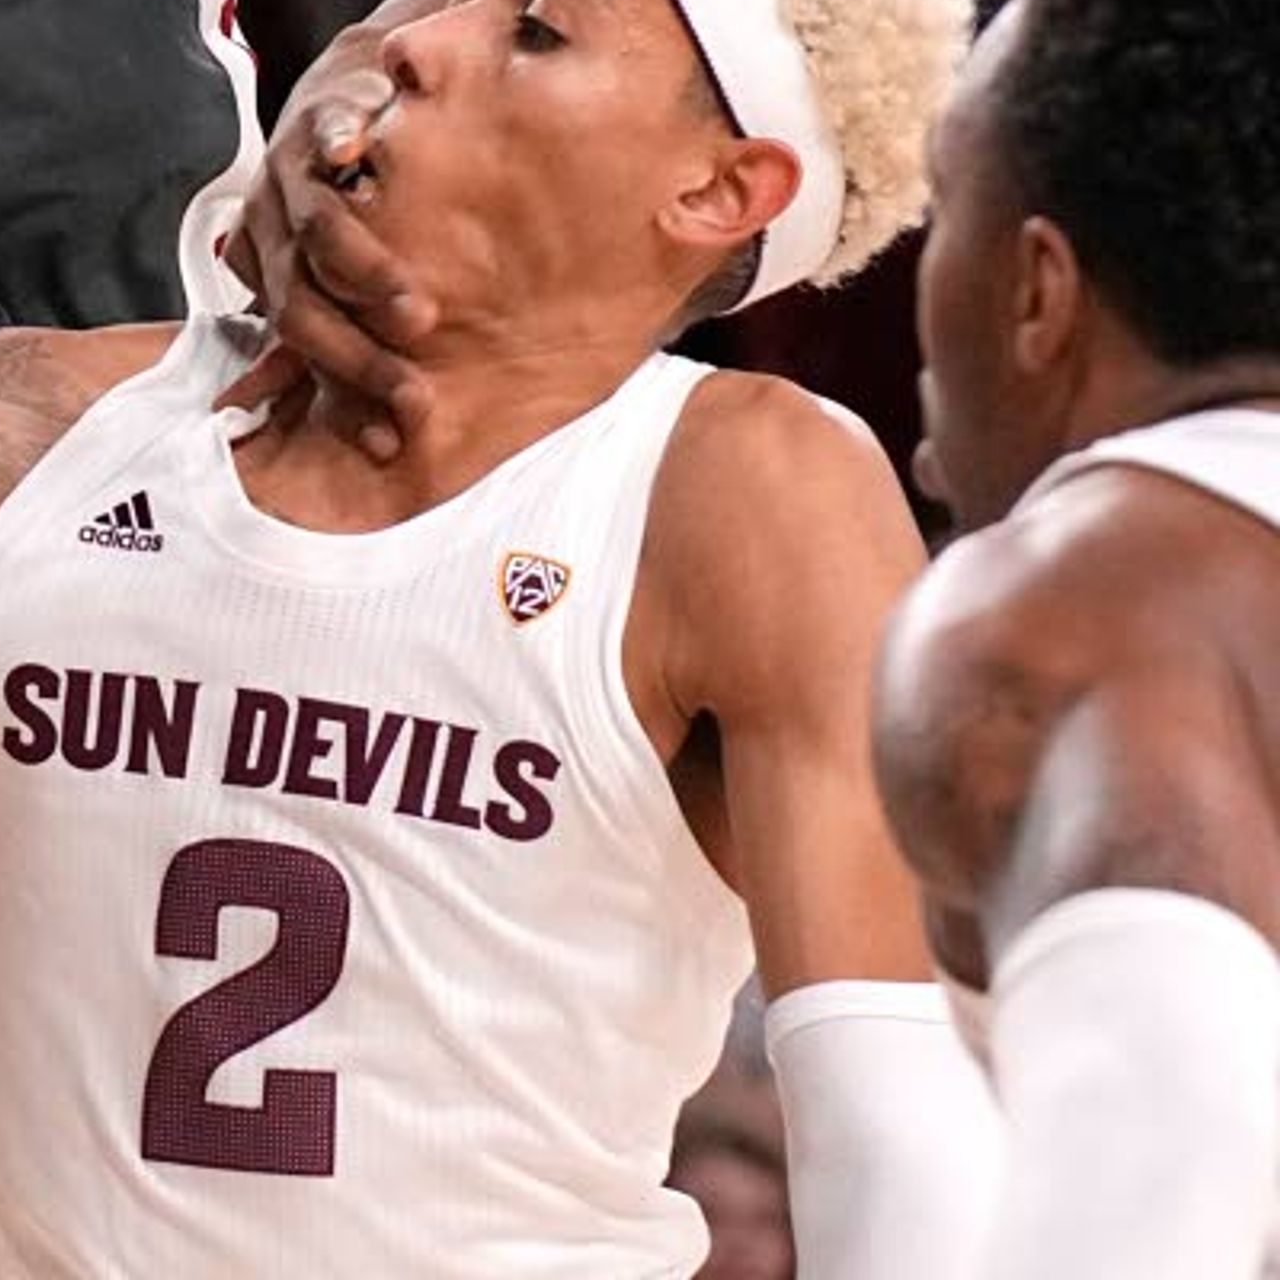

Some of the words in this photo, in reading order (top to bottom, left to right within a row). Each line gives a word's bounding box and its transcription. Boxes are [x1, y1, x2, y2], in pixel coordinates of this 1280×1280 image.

[78, 523, 164, 552] adidas
[506, 556, 566, 603] PAC
[509, 585, 547, 616] 12
[2, 663, 202, 780] SUN
[222, 687, 562, 842] DEVILS
[141, 838, 351, 1177] 2
